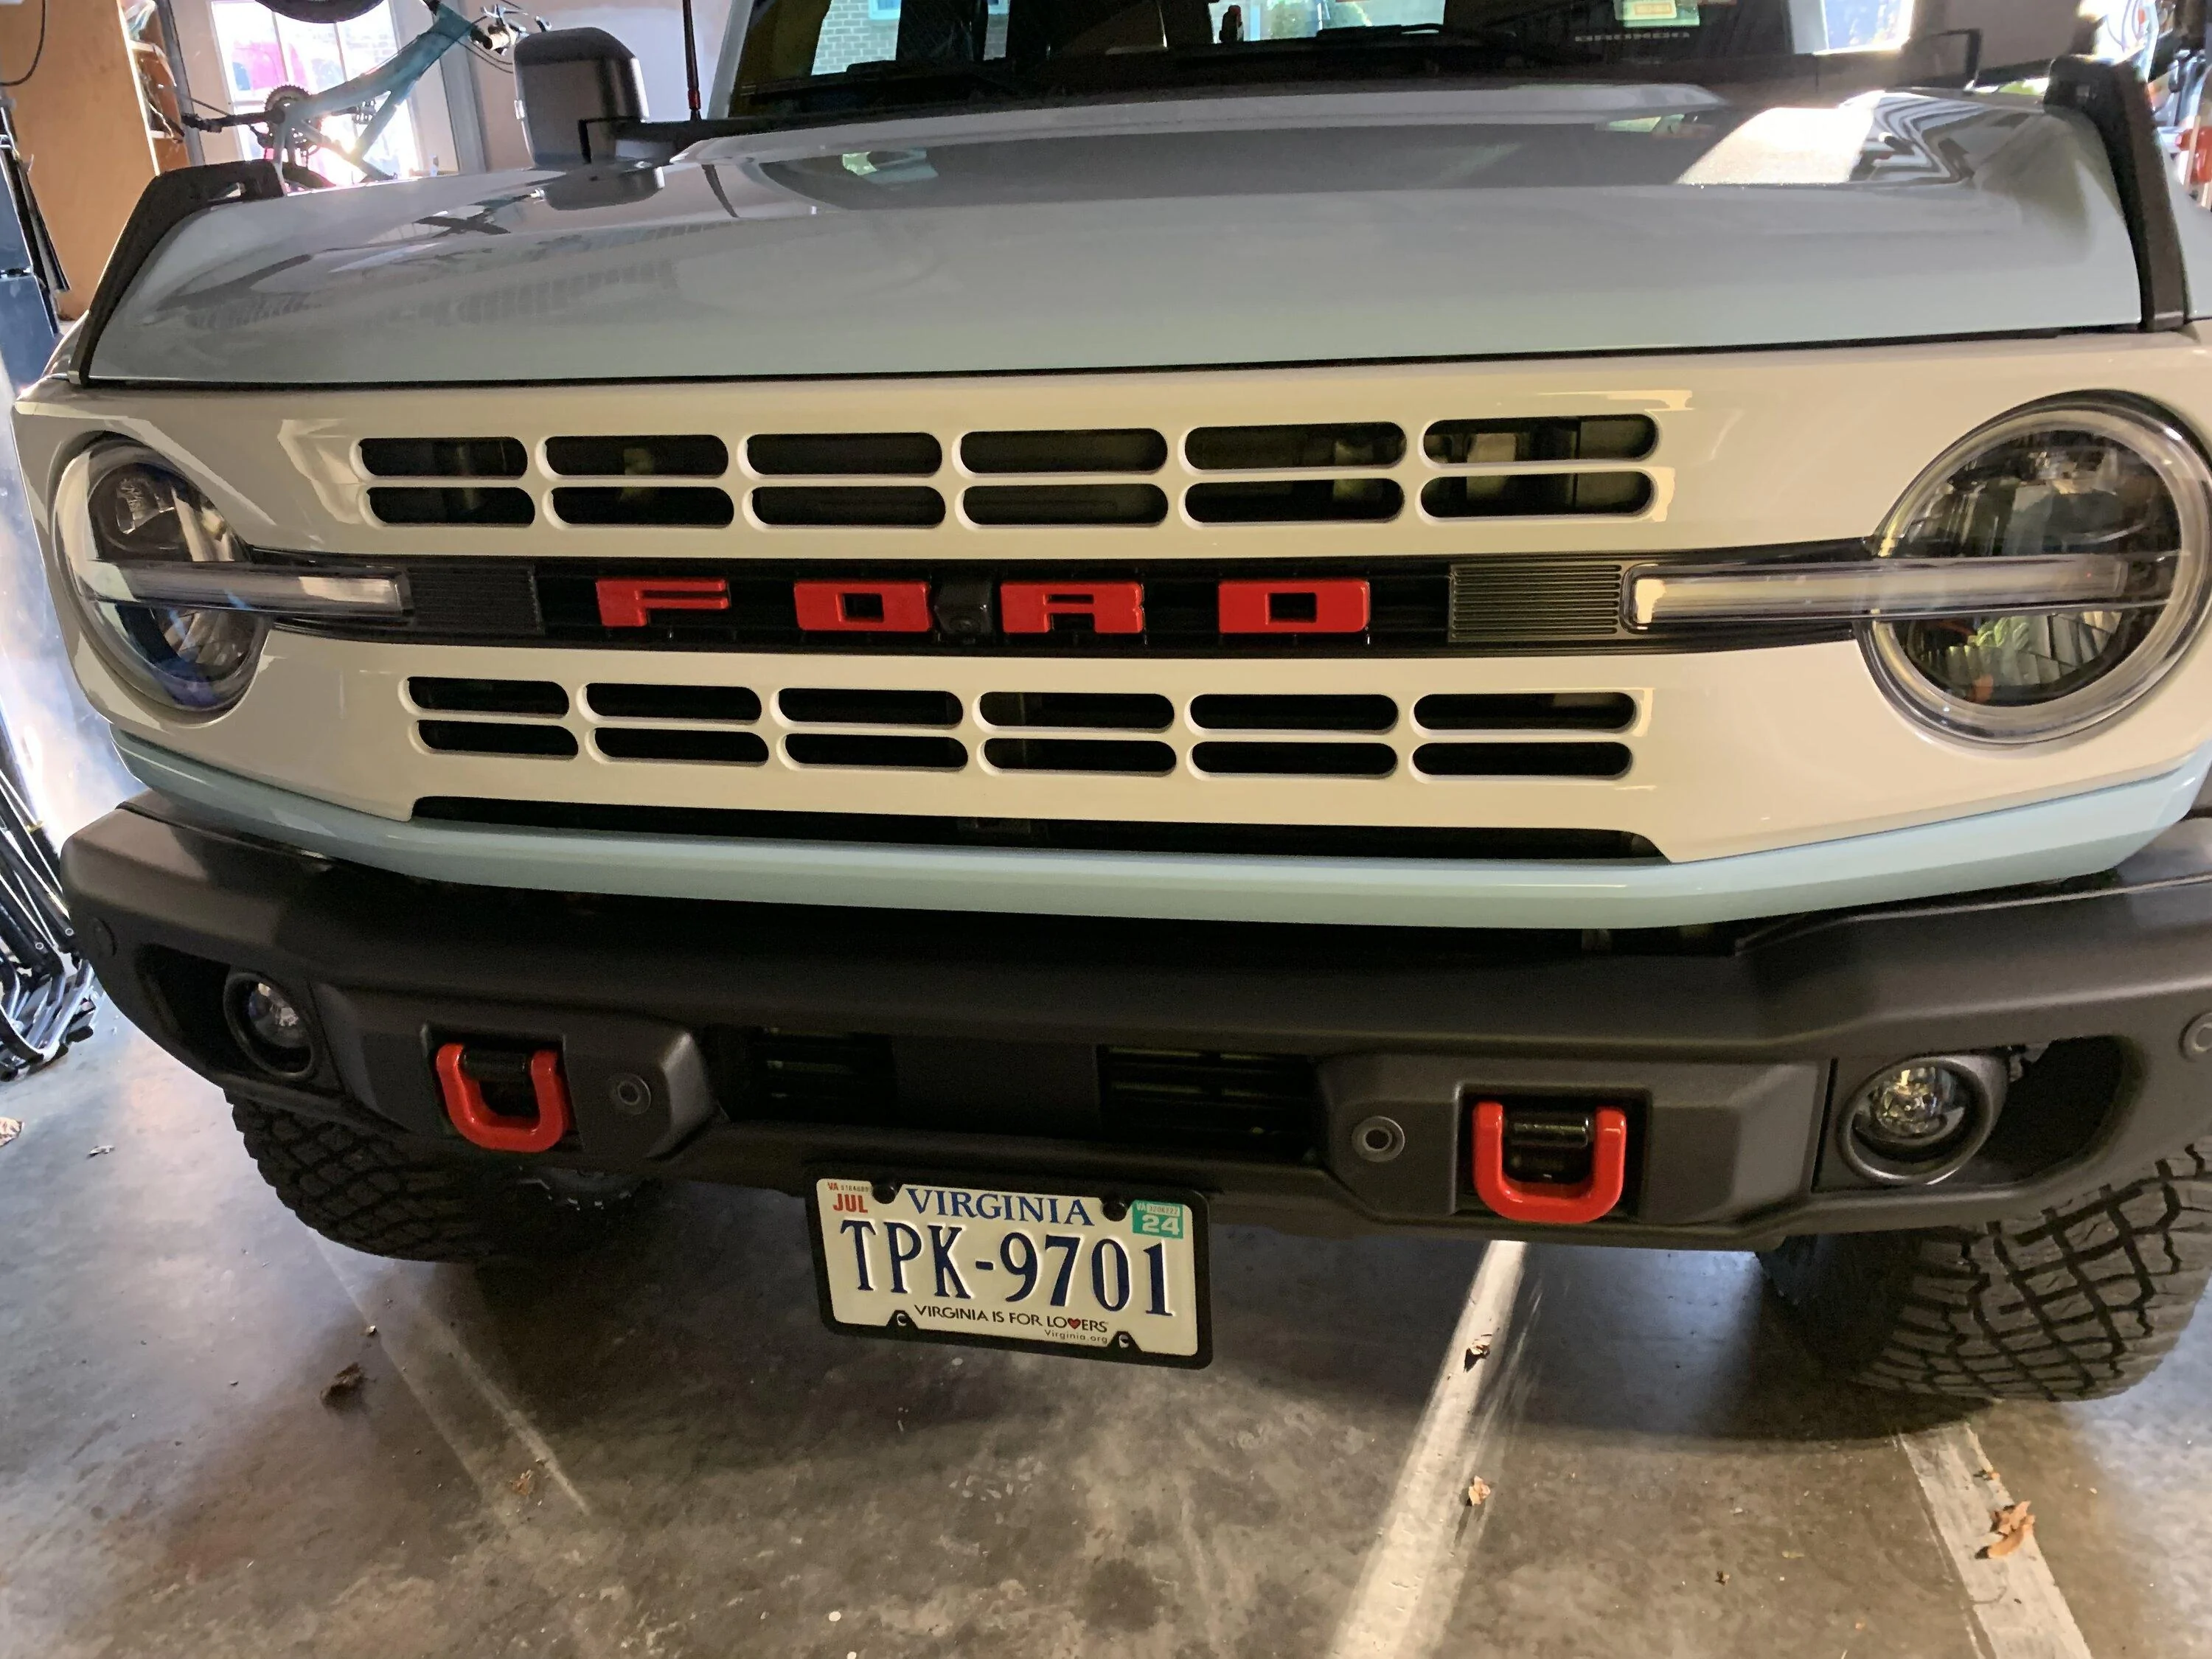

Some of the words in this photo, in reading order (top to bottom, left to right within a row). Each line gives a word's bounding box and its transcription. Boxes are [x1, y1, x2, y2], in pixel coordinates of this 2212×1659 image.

[596, 577, 1370, 636] FORD
[827, 1182, 839, 1191] VA
[832, 1193, 869, 1214] JUL
[905, 1188, 1095, 1226] VIRGINIA
[1136, 1202, 1147, 1211] VA
[1142, 1214, 1180, 1236] 24
[840, 1219, 1174, 1317] TPK-9701
[914, 1304, 989, 1322] VIRGINIA
[992, 1311, 1005, 1323] IS
[1009, 1312, 1043, 1327] FOR
[1044, 1329, 1108, 1344] Virginia.org
